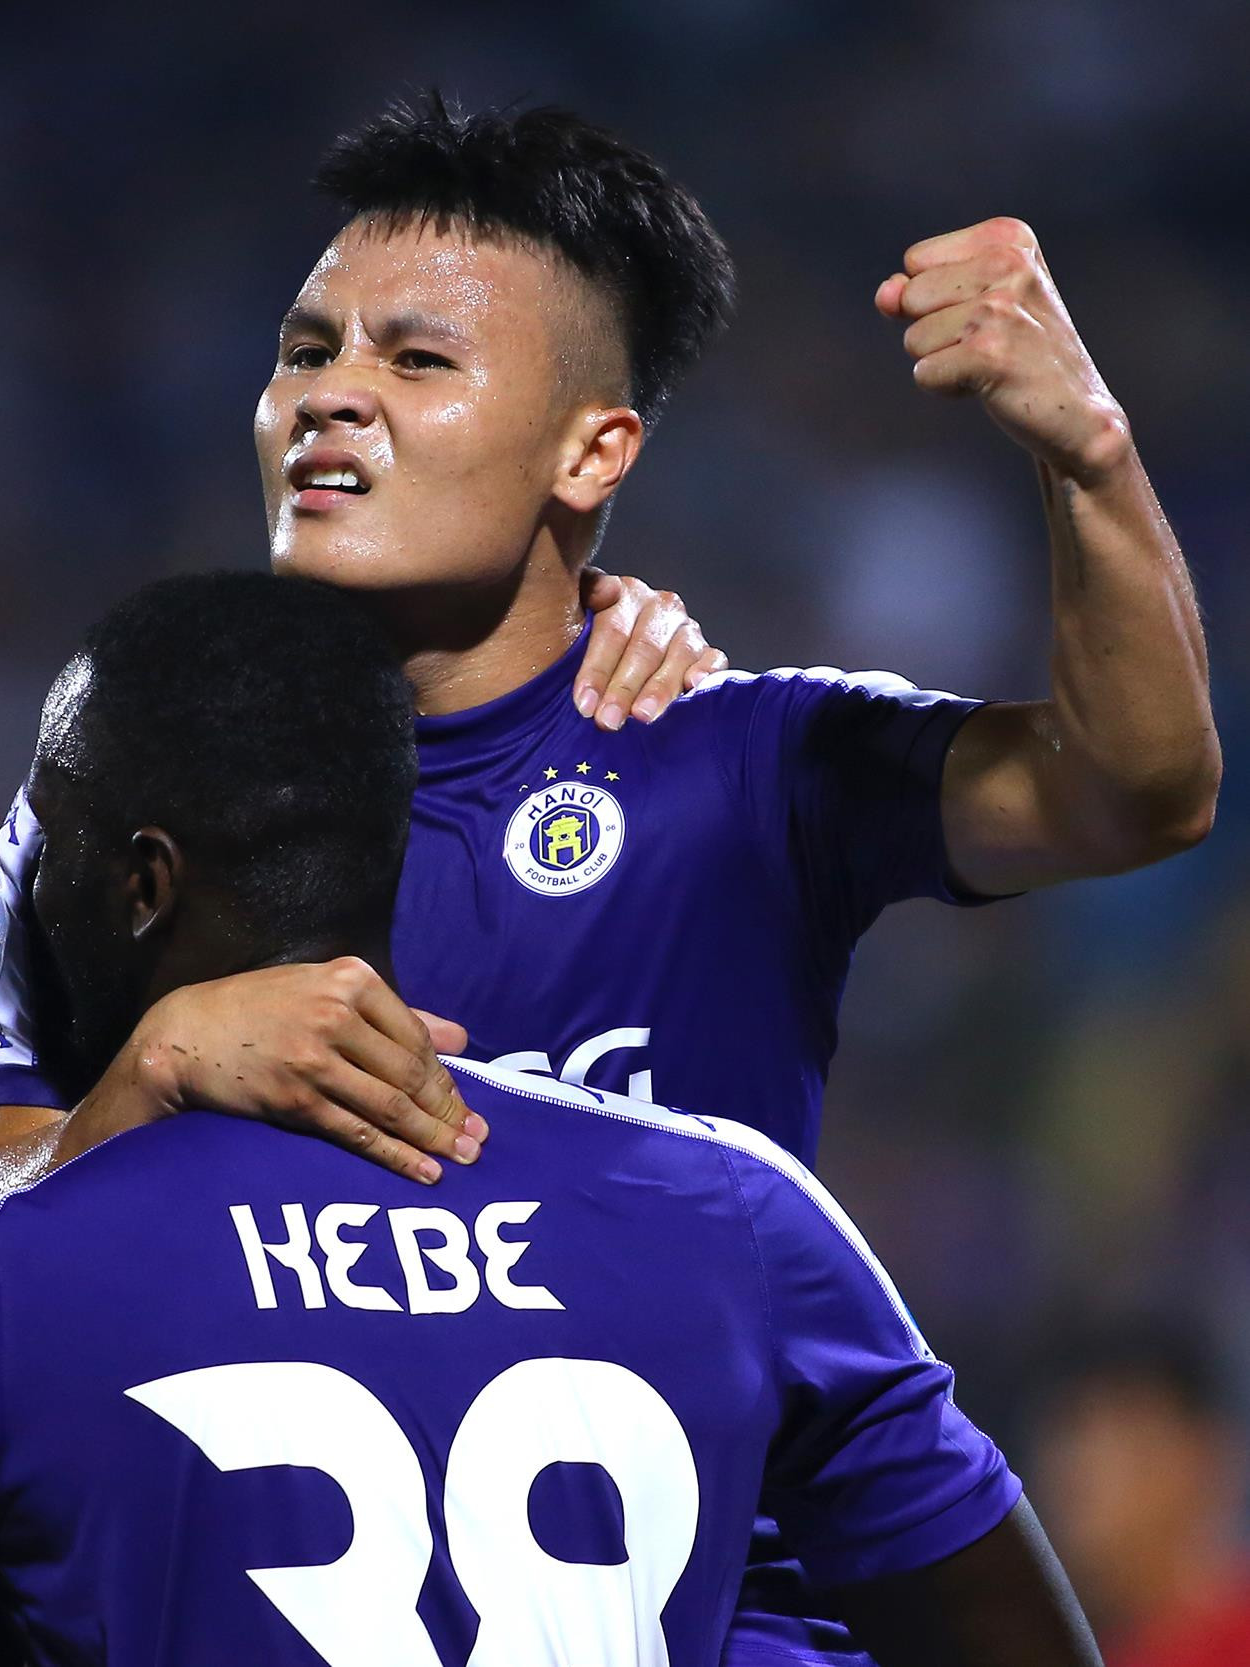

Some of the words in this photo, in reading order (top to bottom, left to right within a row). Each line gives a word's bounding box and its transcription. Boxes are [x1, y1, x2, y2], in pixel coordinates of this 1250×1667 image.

[527, 787, 605, 821] HANOI
[525, 867, 580, 887] FOOTBALL
[583, 852, 609, 877] CLUB
[228, 1200, 567, 1315] KEBE
